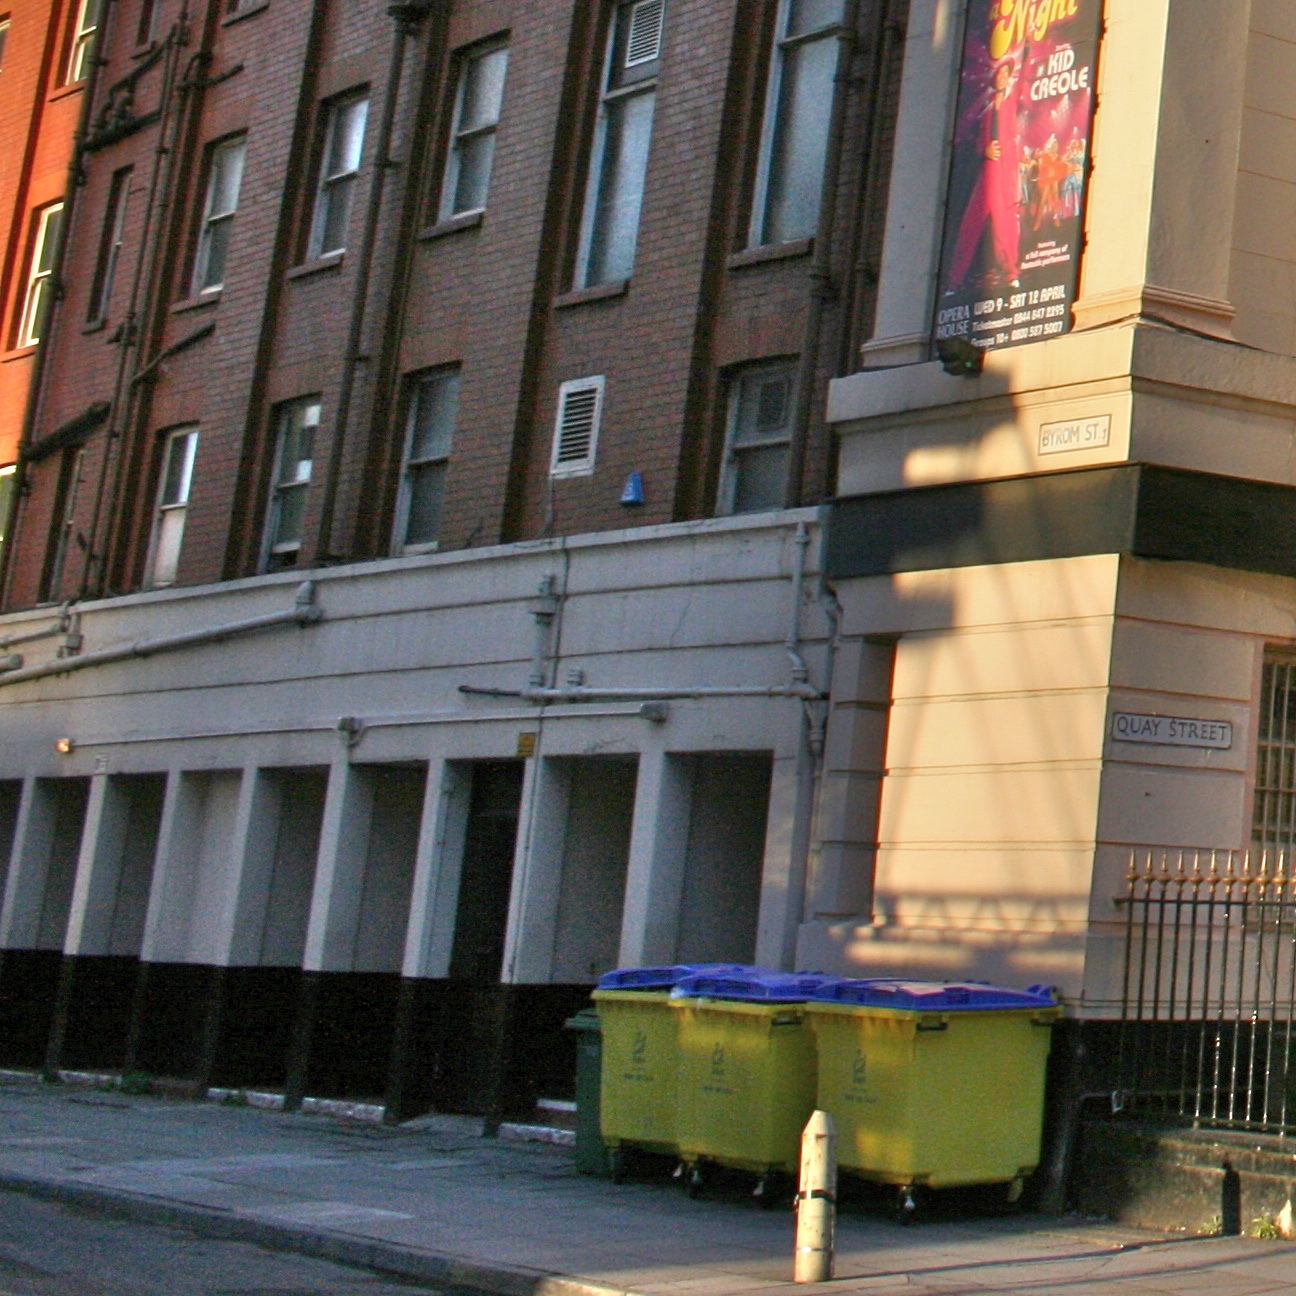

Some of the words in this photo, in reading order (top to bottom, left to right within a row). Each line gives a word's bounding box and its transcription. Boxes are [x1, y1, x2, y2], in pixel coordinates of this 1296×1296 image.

[1047, 49, 1075, 76] KID
[1030, 66, 1089, 101] CREOLE
[973, 299, 995, 316] WED
[996, 297, 1003, 312] 9
[1009, 292, 1027, 310] SAT
[1028, 289, 1039, 306] 12
[1040, 284, 1066, 303] APRIL
[938, 305, 970, 324] OPERA
[937, 320, 970, 339] HOUSE
[1042, 425, 1080, 448] BYROM
[1116, 715, 1161, 737] QUAY
[1168, 718, 1227, 741] STREET
